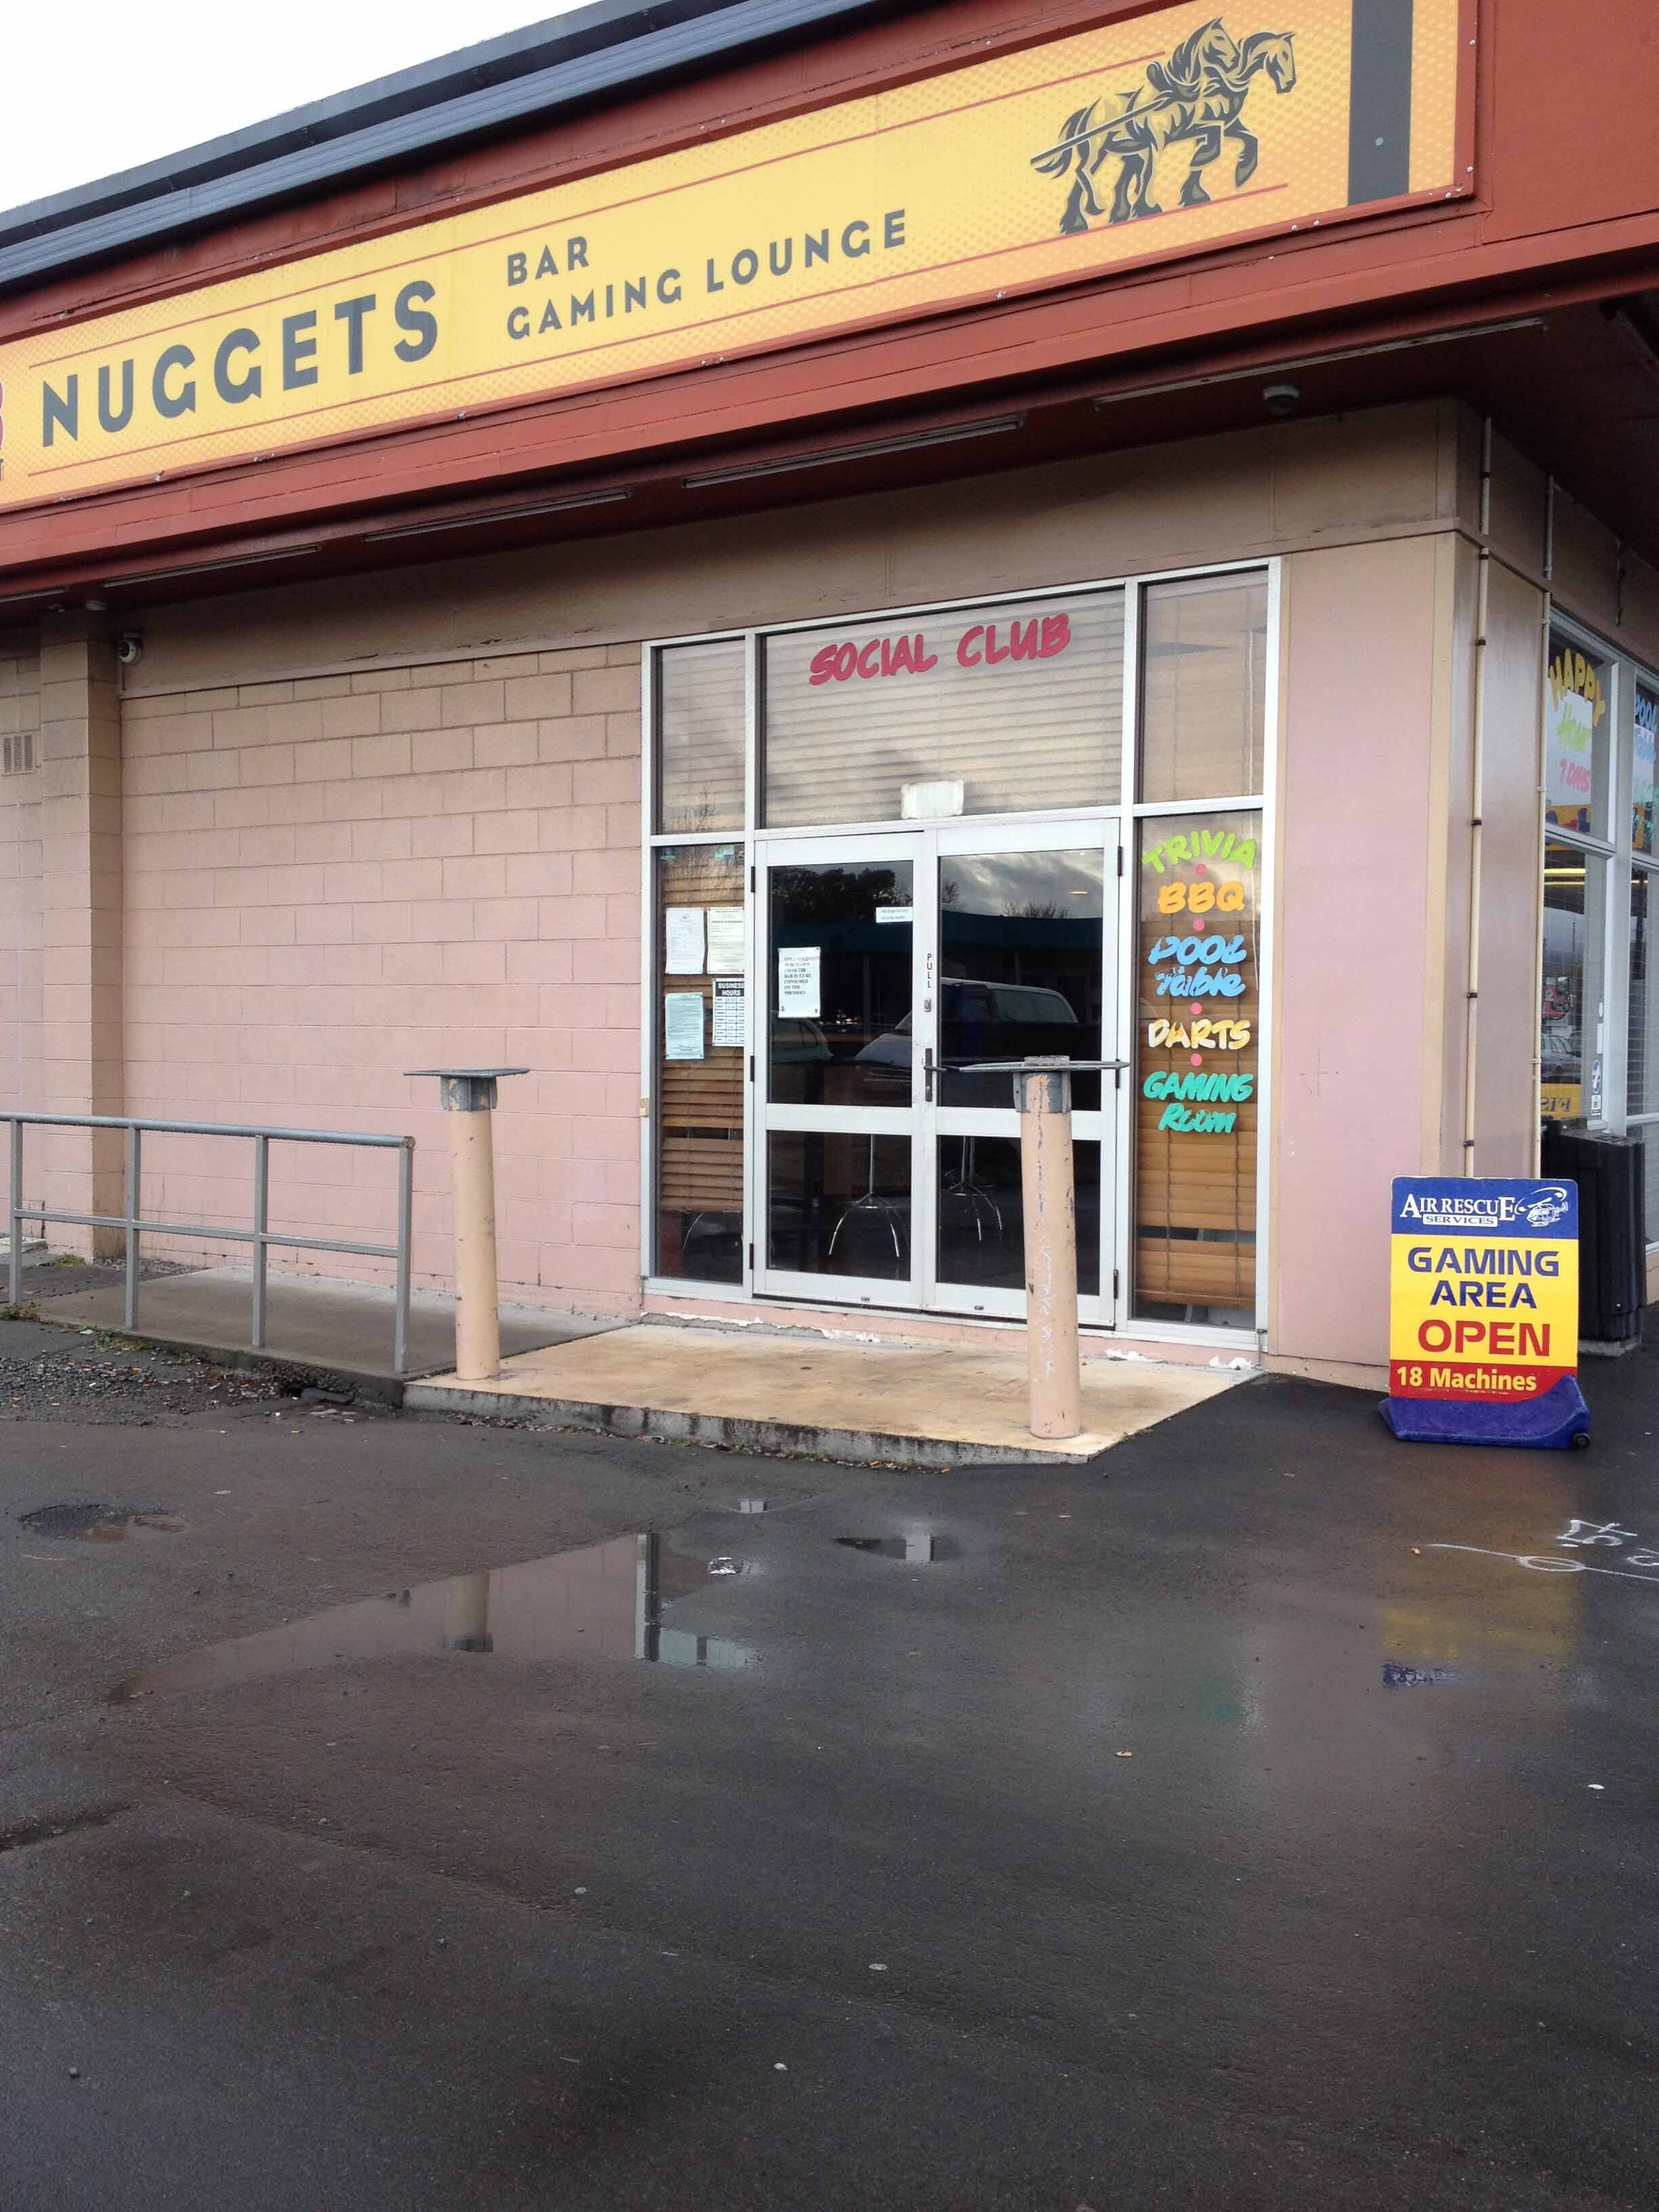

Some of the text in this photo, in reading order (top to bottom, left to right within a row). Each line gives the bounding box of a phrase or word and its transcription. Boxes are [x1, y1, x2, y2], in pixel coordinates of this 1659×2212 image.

[507, 209, 905, 340] GAMING LOUNGE
[508, 236, 589, 286] BAR
[43, 280, 438, 447] NUGGETS
[808, 613, 1071, 686] SOCIAL CLUB
[1549, 647, 1605, 727] HAPPY
[1141, 829, 1257, 874] TRIVIA
[1158, 880, 1245, 914] BBQ
[1148, 935, 1248, 965] POOL
[1148, 1019, 1251, 1050] DARTS
[1143, 1071, 1254, 1103] GAMING
[1399, 1193, 1515, 1221] AIR RESCUE
[1426, 1215, 1494, 1225] SERVICES
[1407, 1247, 1559, 1277] GAMING
[1429, 1280, 1537, 1309] AREA
[1418, 1319, 1551, 1357] OPEN
[1396, 1366, 1537, 1391] 18 Machines
